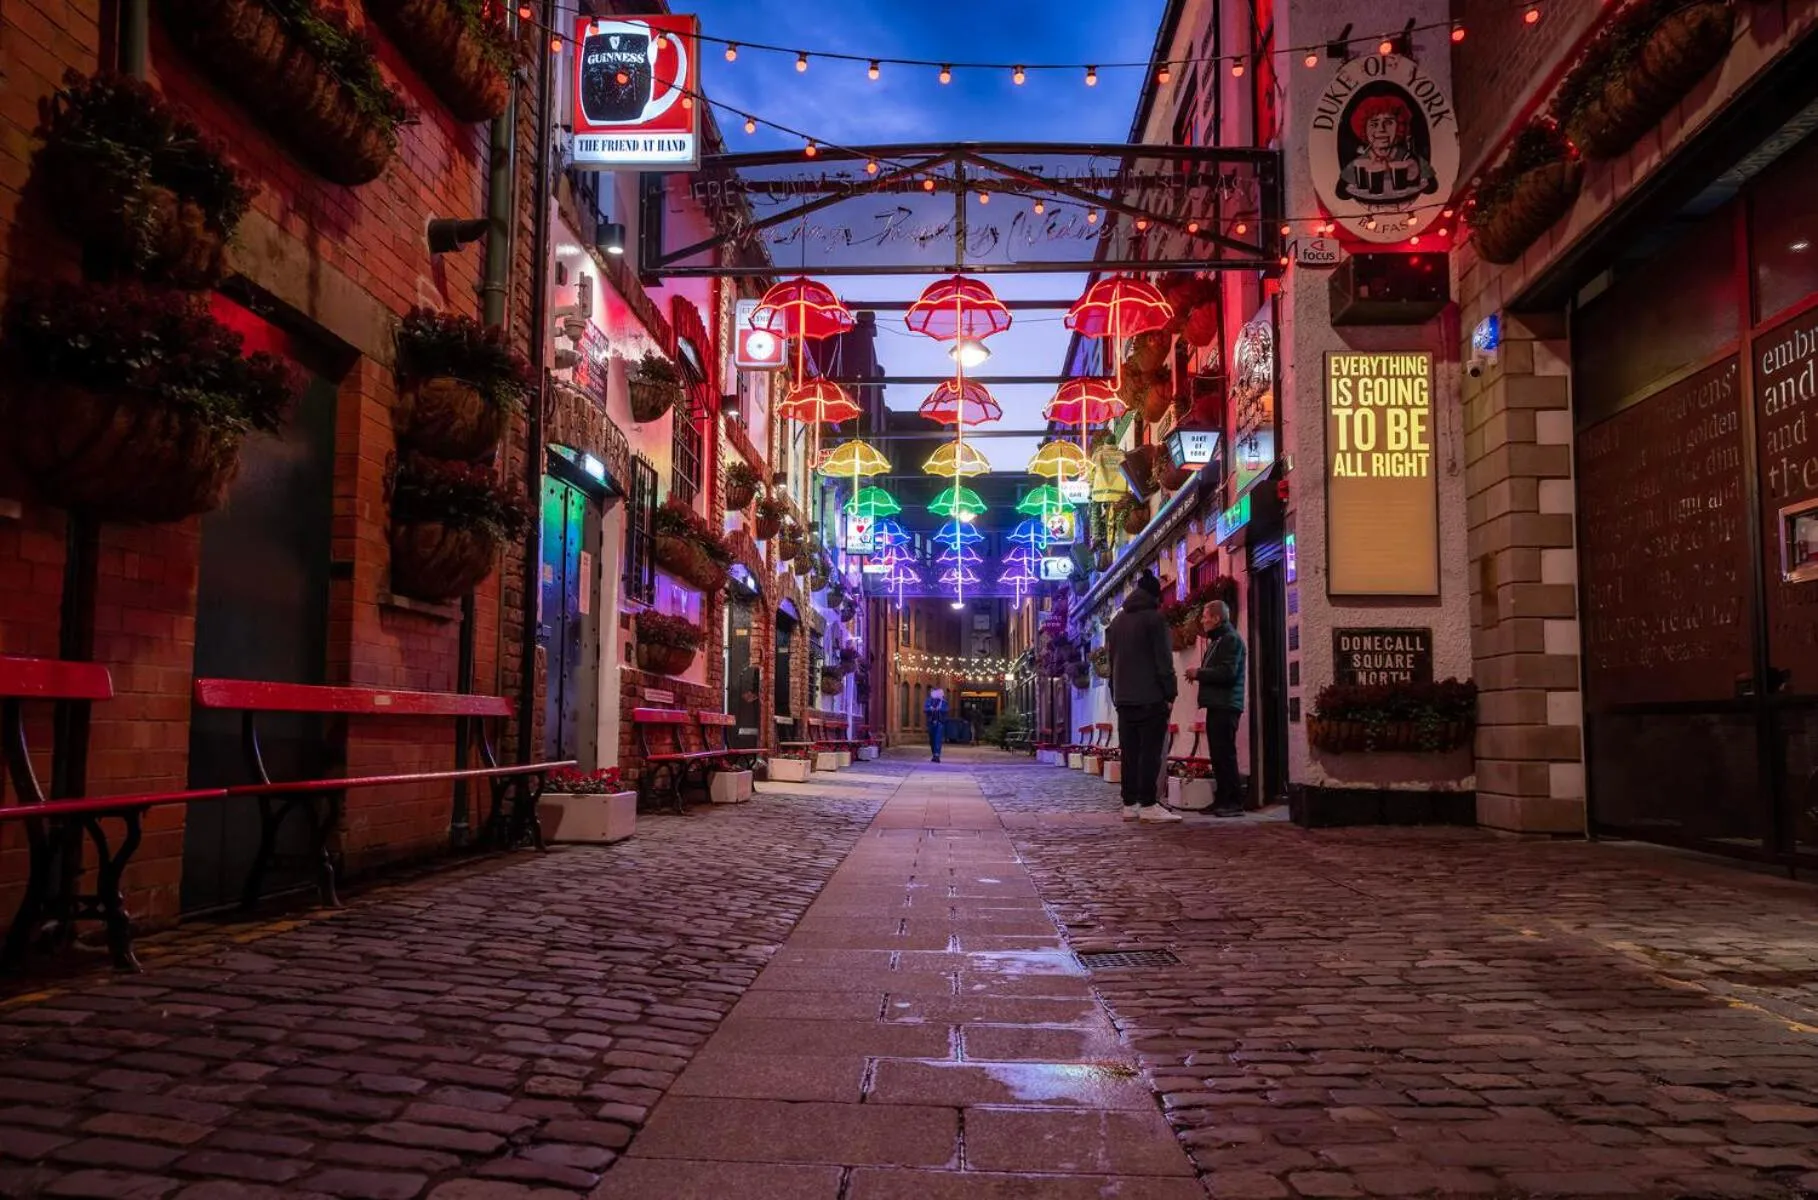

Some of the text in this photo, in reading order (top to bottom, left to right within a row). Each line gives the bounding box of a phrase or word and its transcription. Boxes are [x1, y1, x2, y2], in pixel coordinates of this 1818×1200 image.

[588, 51, 645, 64] GUINNESS
[1313, 55, 1453, 131] DUKE OF YORK
[579, 139, 686, 152] THE FRIEND AT HAND
[1358, 216, 1415, 234] BLFAS
[1303, 248, 1335, 260] focus
[1330, 356, 1429, 377] EVERYTHING
[1331, 377, 1429, 406] IS GOING
[1765, 359, 1816, 416] and
[1332, 408, 1430, 451] TO BE
[1687, 410, 1738, 450] golden
[1767, 411, 1808, 455] and
[1333, 452, 1430, 477] ALL RIGHT
[1353, 653, 1415, 669] SQUARE
